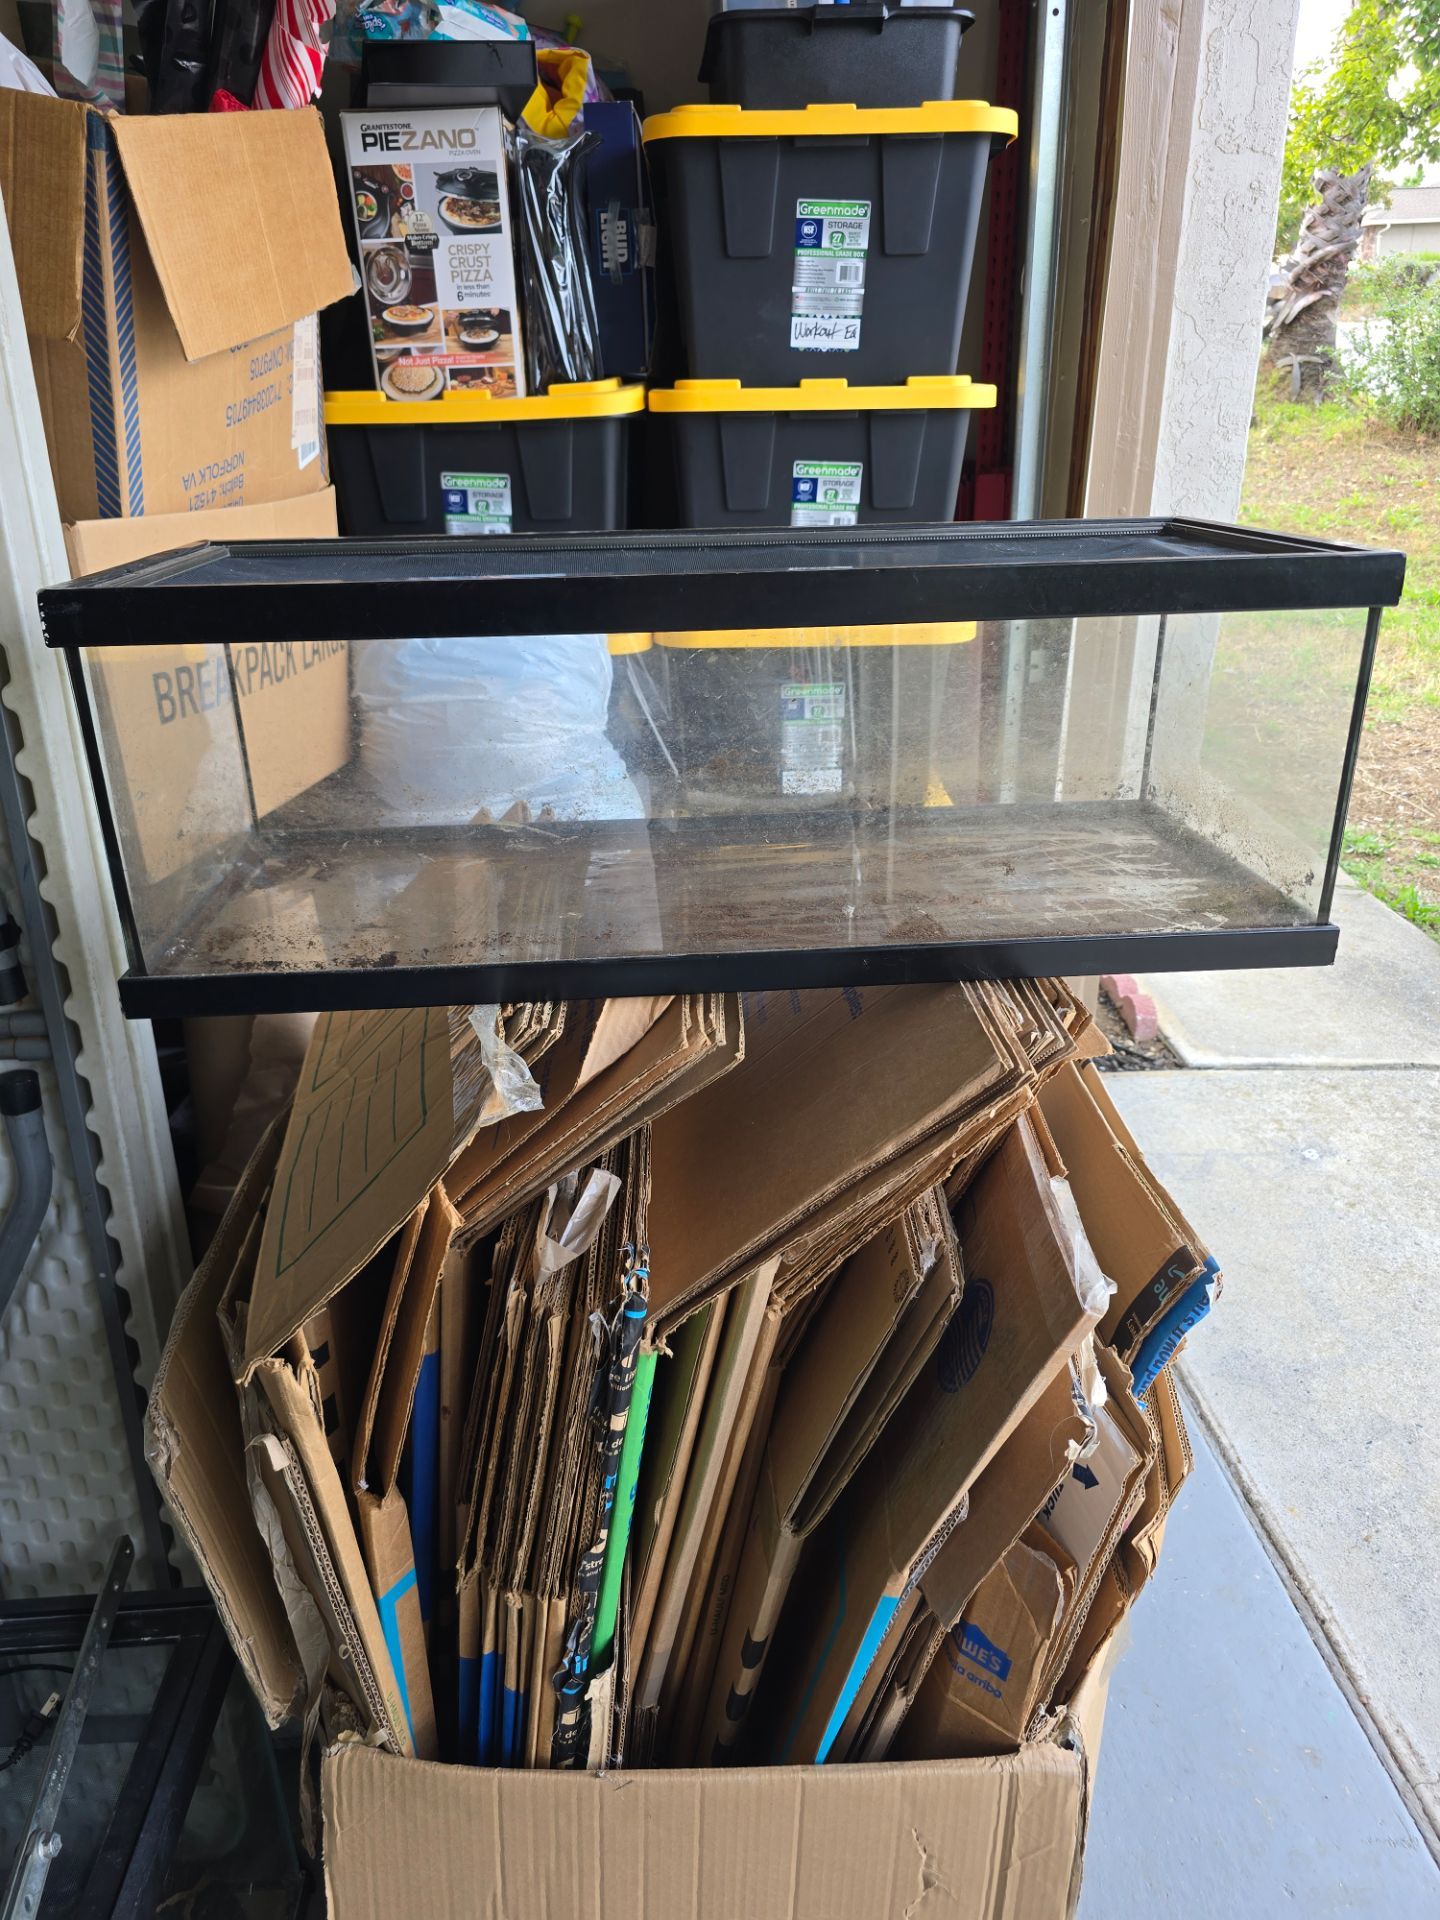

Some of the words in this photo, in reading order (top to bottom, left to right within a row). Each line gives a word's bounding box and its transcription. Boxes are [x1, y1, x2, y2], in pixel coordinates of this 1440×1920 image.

[360, 122, 412, 132] GRANITESTONE
[361, 128, 477, 152] PIEZANO
[800, 203, 866, 217] Greenmade
[803, 225, 815, 234] NSF
[827, 221, 864, 230] STORAGE
[615, 220, 629, 263] BUD
[832, 232, 843, 243] 27
[447, 242, 491, 256] CRISPY
[797, 249, 834, 257] PROFESSIONAL
[853, 250, 865, 258] BOX
[448, 255, 492, 269] CRUST
[450, 268, 494, 283] PIZZA
[457, 291, 464, 302] 6
[794, 321, 844, 341] Workout
[398, 357, 413, 366] Not
[415, 356, 431, 365] Just
[200, 451, 245, 484] NORFOLK
[796, 464, 859, 476] Greenmade
[182, 470, 198, 491] VA
[444, 476, 507, 488] Greenmade
[1154, 1337, 1177, 1368] now
[966, 1671, 1003, 1699] arriba
